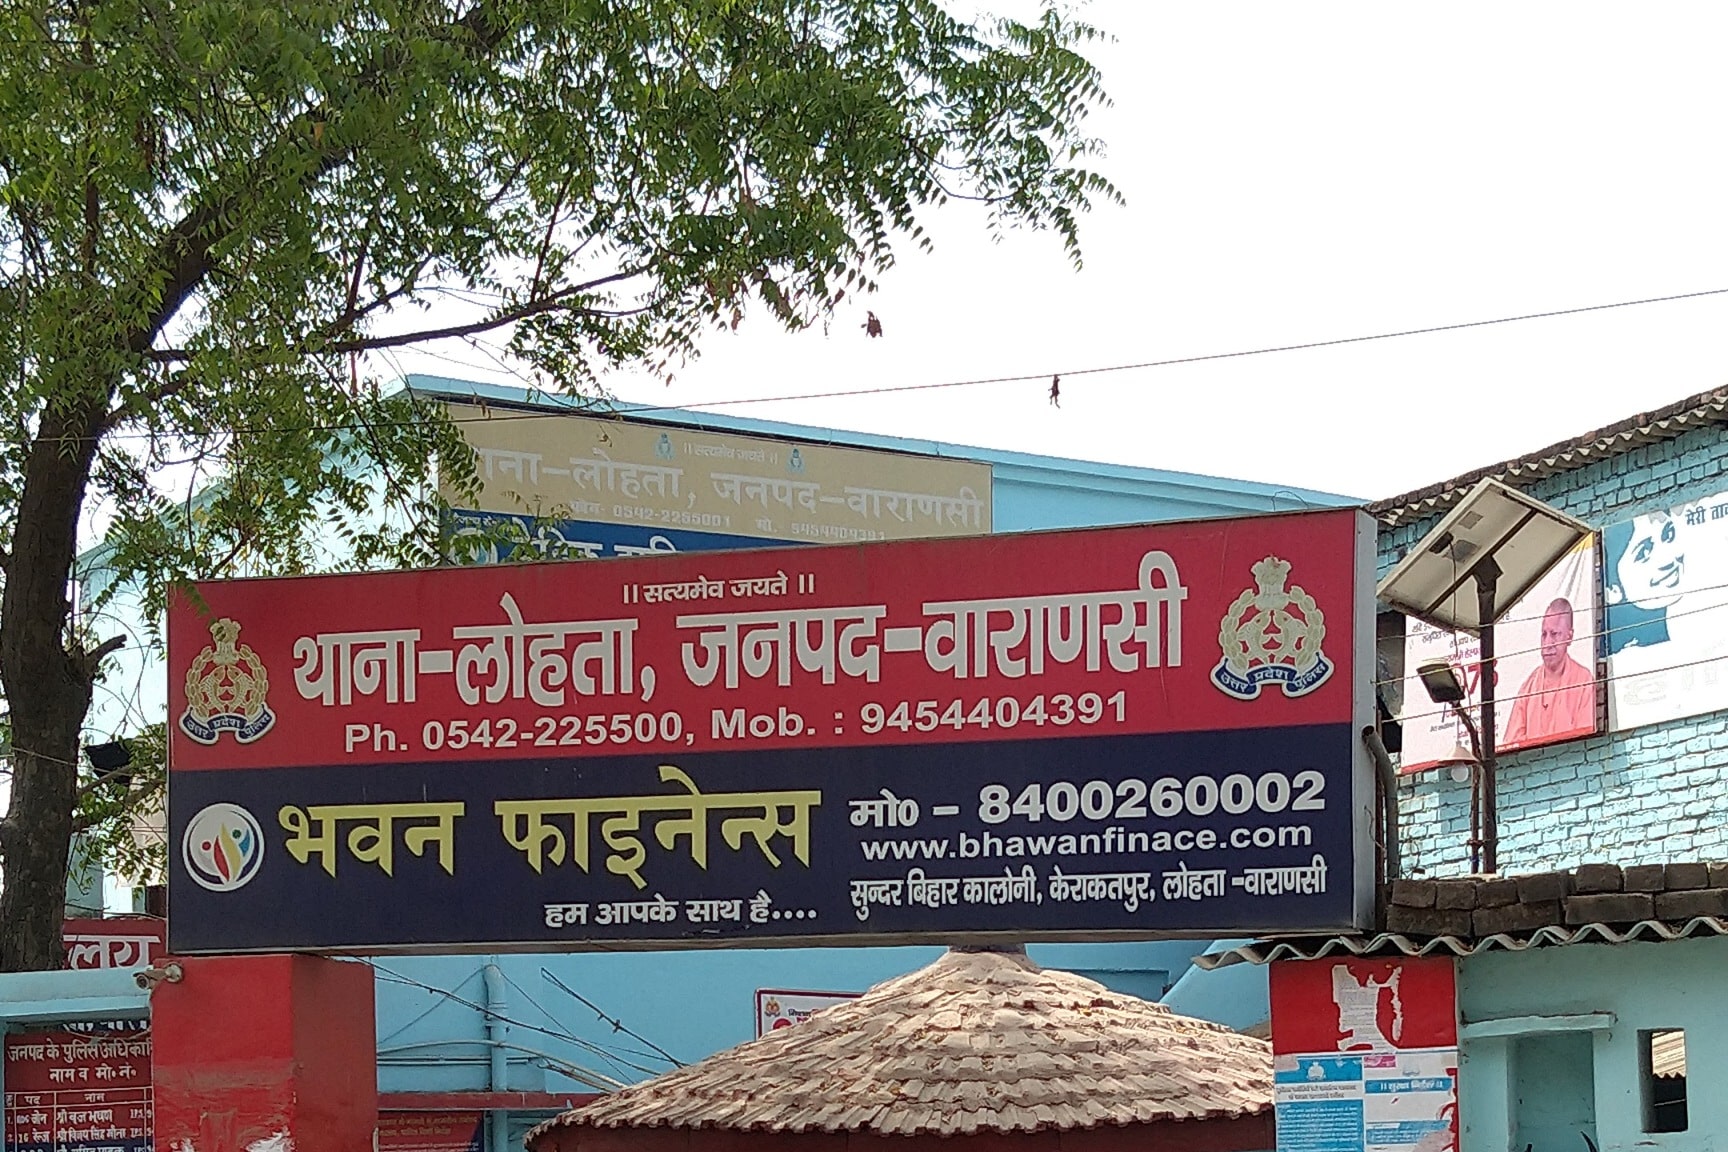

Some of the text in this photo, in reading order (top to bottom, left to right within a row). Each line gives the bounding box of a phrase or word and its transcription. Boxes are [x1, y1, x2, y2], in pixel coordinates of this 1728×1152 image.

[1685, 506, 1707, 525] मेरी
[643, 575, 725, 603] सत्यमेव
[729, 570, 788, 597] जयते
[344, 721, 409, 754] Ph.
[421, 711, 696, 751] 0542-225500,
[710, 703, 817, 739] Mob.
[860, 690, 1128, 734] 9454404391
[978, 770, 1326, 824] 8400260002
[278, 764, 822, 890] भवन फाइनेन्स
[860, 820, 1313, 861] www.bhawanfinace.com
[850, 879, 903, 921] सुन्दर
[907, 867, 959, 906] बिहार
[963, 865, 1043, 907] कालोनी,
[1049, 865, 1156, 913] केराकतपुर,
[1162, 861, 1226, 903] लोहता
[544, 902, 587, 928] हम
[594, 893, 678, 926] आपके
[685, 898, 743, 923] साथ
[8, 1038, 152, 1063] जनपद के पुलिस अधिका
[49, 1067, 75, 1082] नाम
[78, 1067, 89, 1081] व
